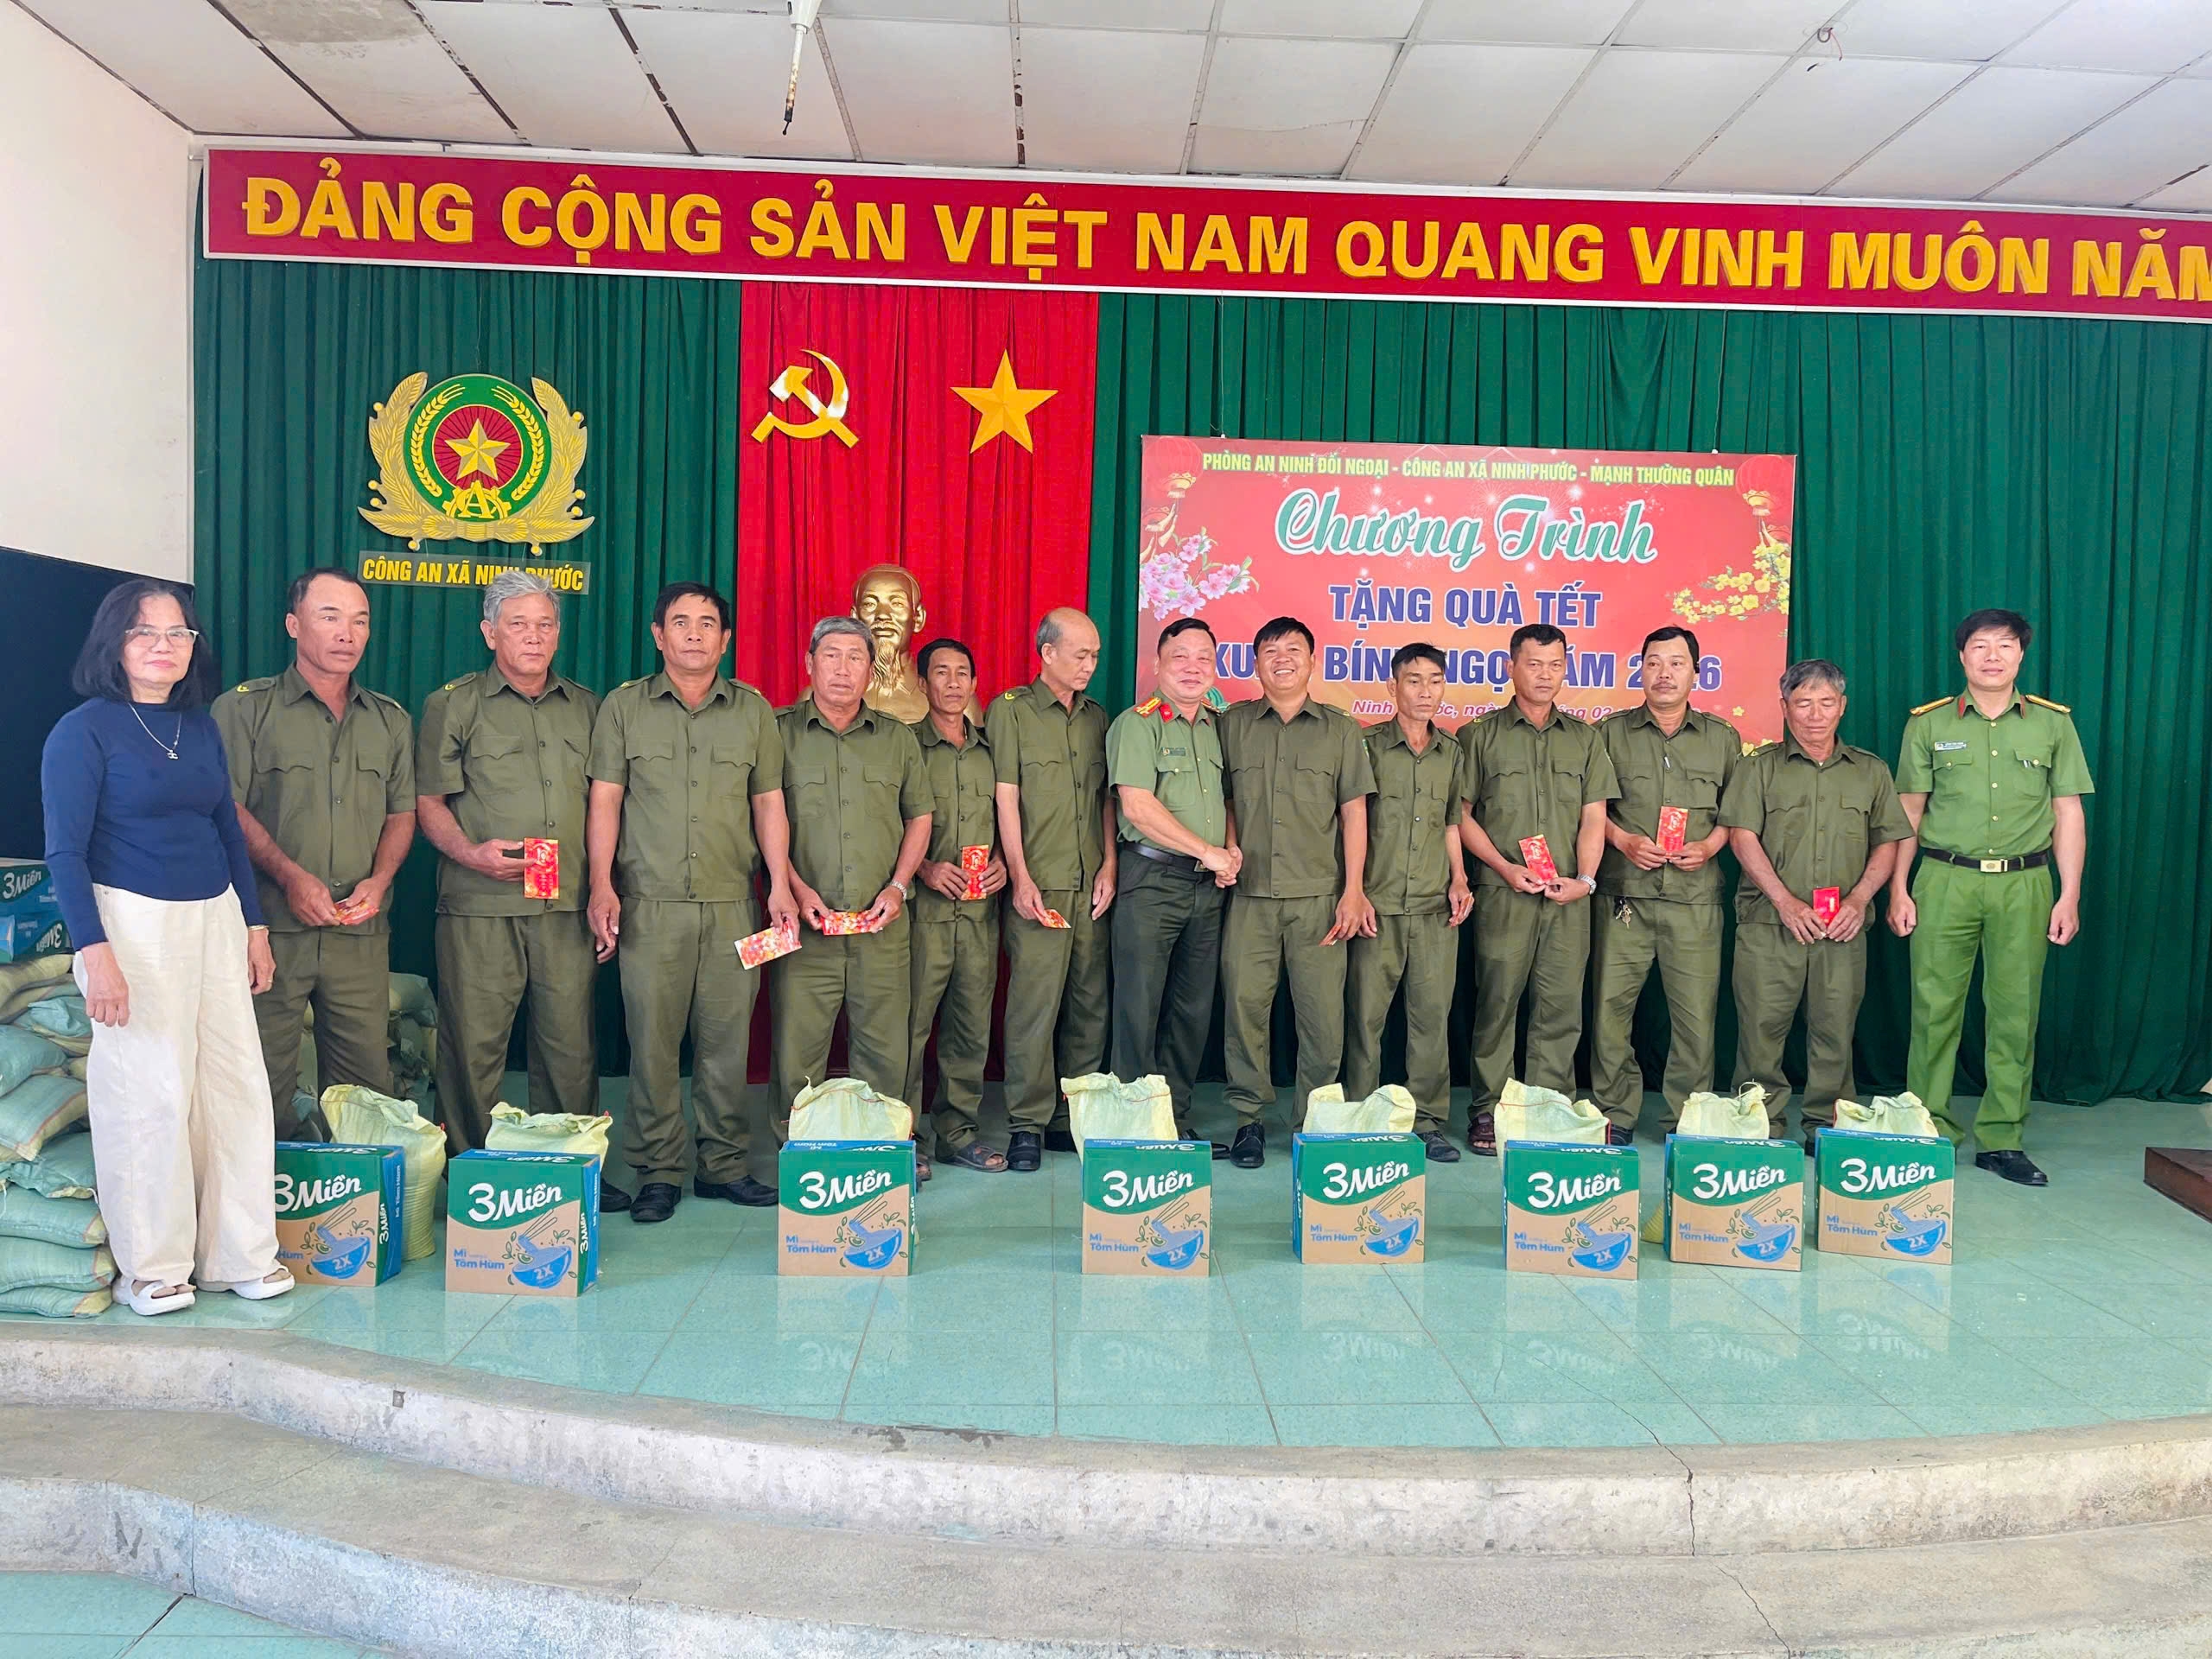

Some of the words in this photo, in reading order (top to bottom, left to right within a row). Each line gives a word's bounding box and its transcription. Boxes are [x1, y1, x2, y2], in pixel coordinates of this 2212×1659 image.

[243, 159, 473, 243] ĐẢNG
[502, 175, 721, 264] CỘNG
[750, 180, 906, 261] SẢN
[934, 193, 1107, 281] VIỆT
[1136, 213, 1307, 274] NAM
[1336, 220, 1604, 283] QUANG
[1630, 226, 1804, 288] VINH
[1830, 220, 2049, 294] MUÔN
[1203, 450, 1251, 471] PHÒNG
[1255, 455, 1274, 472] AN
[1279, 456, 1314, 474] NINH
[1318, 453, 1341, 474] ĐỐI
[1345, 459, 1389, 478] NGOẠI
[1402, 457, 1443, 477] CÔNG
[1445, 461, 1465, 477] AN
[1469, 460, 1488, 478] XÃ
[1492, 462, 1527, 480] NINH
[1530, 461, 1577, 480] PHƯỚC
[1591, 466, 1633, 486] MẠNH
[1637, 463, 1692, 485] THƯỜNG
[1695, 466, 1735, 486] QUÂN
[1276, 491, 1484, 569] Chương
[1497, 497, 1656, 561] Trình
[362, 556, 412, 582] CÔNG
[416, 561, 442, 583] AN
[446, 559, 470, 585] XÃ
[1330, 579, 1431, 630] TẶNG
[1446, 581, 1522, 628] QUÀ
[1535, 580, 1601, 626] TẾT
[1325, 640, 1392, 682] BÍN
[1627, 655, 1721, 691] 26
[1352, 700, 1394, 715] Ninh
[1384, 1235, 1402, 1249] 2X
[1758, 1240, 1777, 1255] 2X
[1907, 1234, 1928, 1249] 2X
[864, 1247, 887, 1262] 2X
[1167, 1247, 1188, 1262] 2X
[1593, 1249, 1614, 1264] 2X
[332, 1256, 351, 1270] 2X
[533, 1265, 554, 1280] 2X
